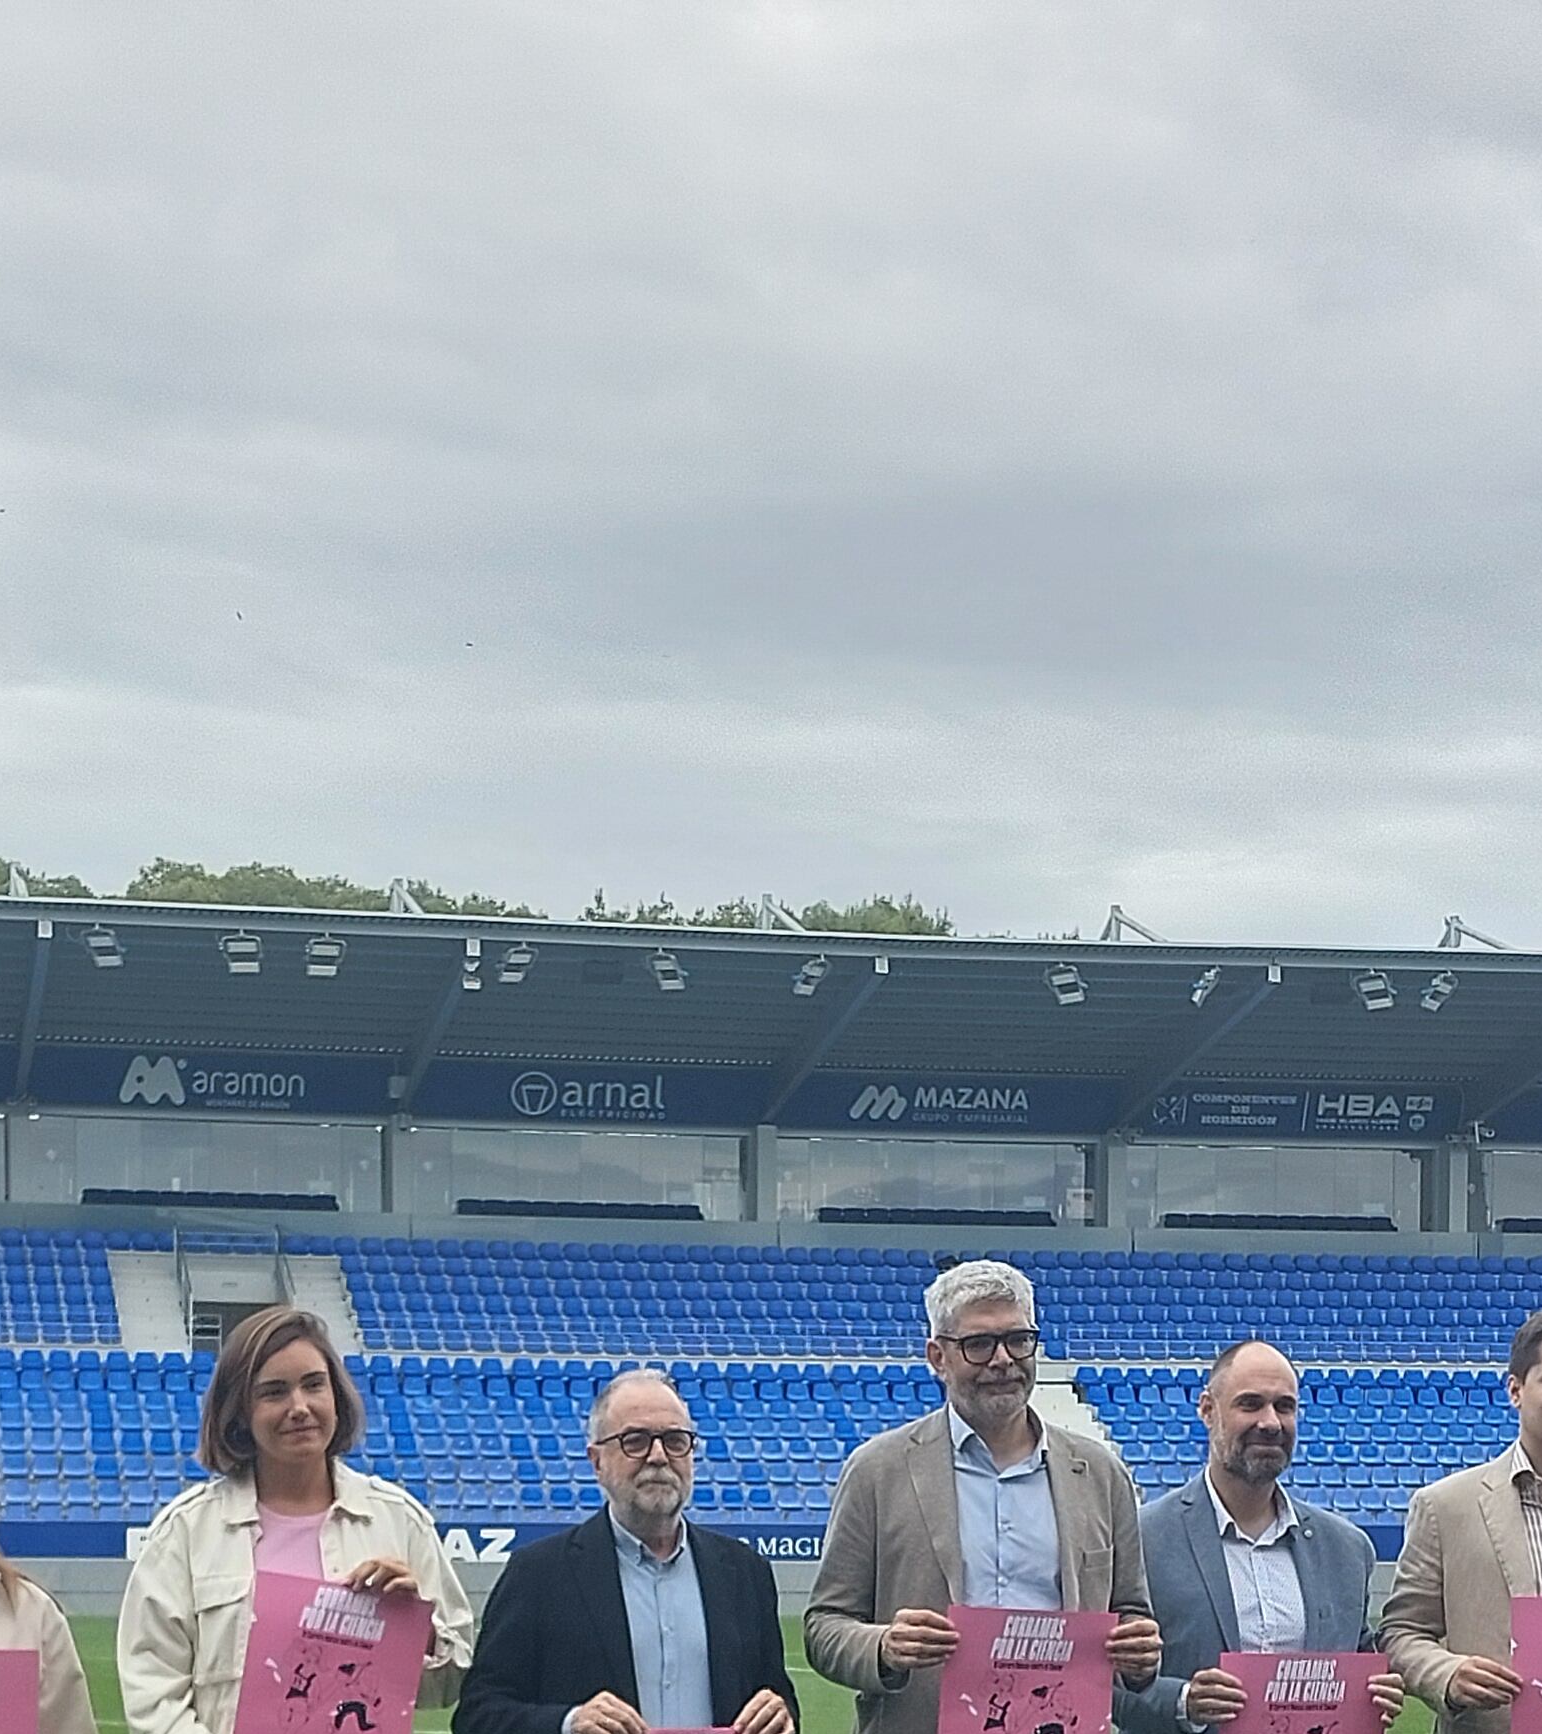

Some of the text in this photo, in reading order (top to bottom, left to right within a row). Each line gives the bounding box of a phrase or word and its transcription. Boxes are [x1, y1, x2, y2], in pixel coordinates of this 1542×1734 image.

[192, 1071, 305, 1097] aramon
[562, 1075, 665, 1109] arnal
[914, 1087, 1028, 1110] MAZANA
[1231, 1105, 1250, 1114] DE
[1318, 1094, 1401, 1117] HBA
[561, 1109, 666, 1119] ELECTRICIDAD
[912, 1112, 1029, 1123] GRUPO EMPRESARIAL
[1003, 1615, 1066, 1640] CORRAMOS
[990, 1639, 1074, 1662] POR LA CIENCIA
[1276, 1659, 1337, 1680] CORRAMOS
[1265, 1681, 1346, 1702] POR LA CIENCIA
